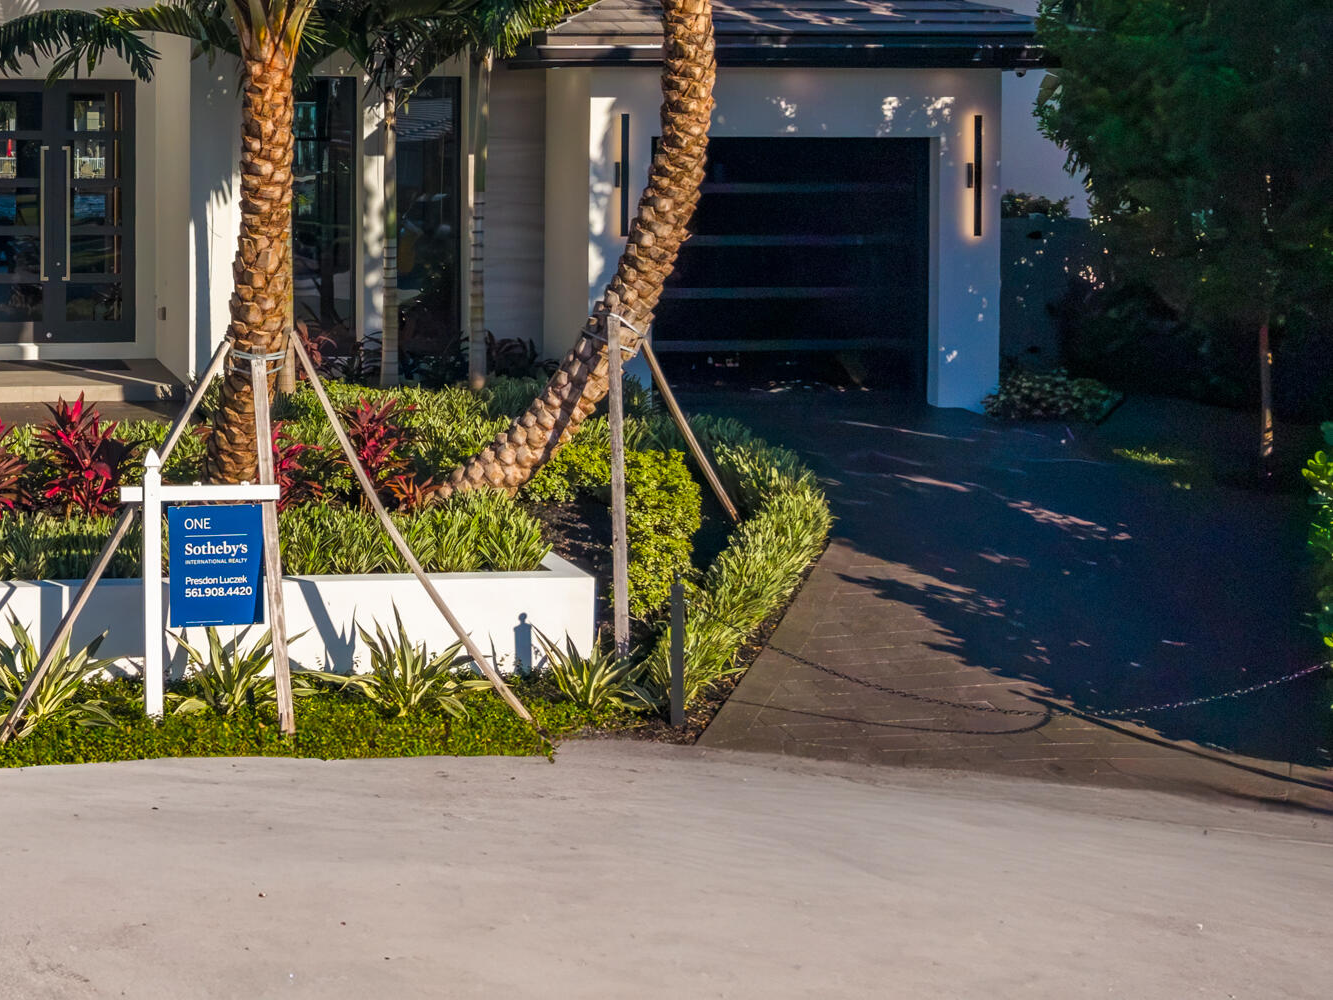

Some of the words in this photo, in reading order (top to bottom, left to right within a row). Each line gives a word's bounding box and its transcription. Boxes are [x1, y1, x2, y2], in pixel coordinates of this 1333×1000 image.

[184, 518, 211, 529] ONE
[184, 541, 248, 557] Sotheby's
[219, 574, 248, 584] Luczek
[184, 586, 253, 598] 561.908.4420
